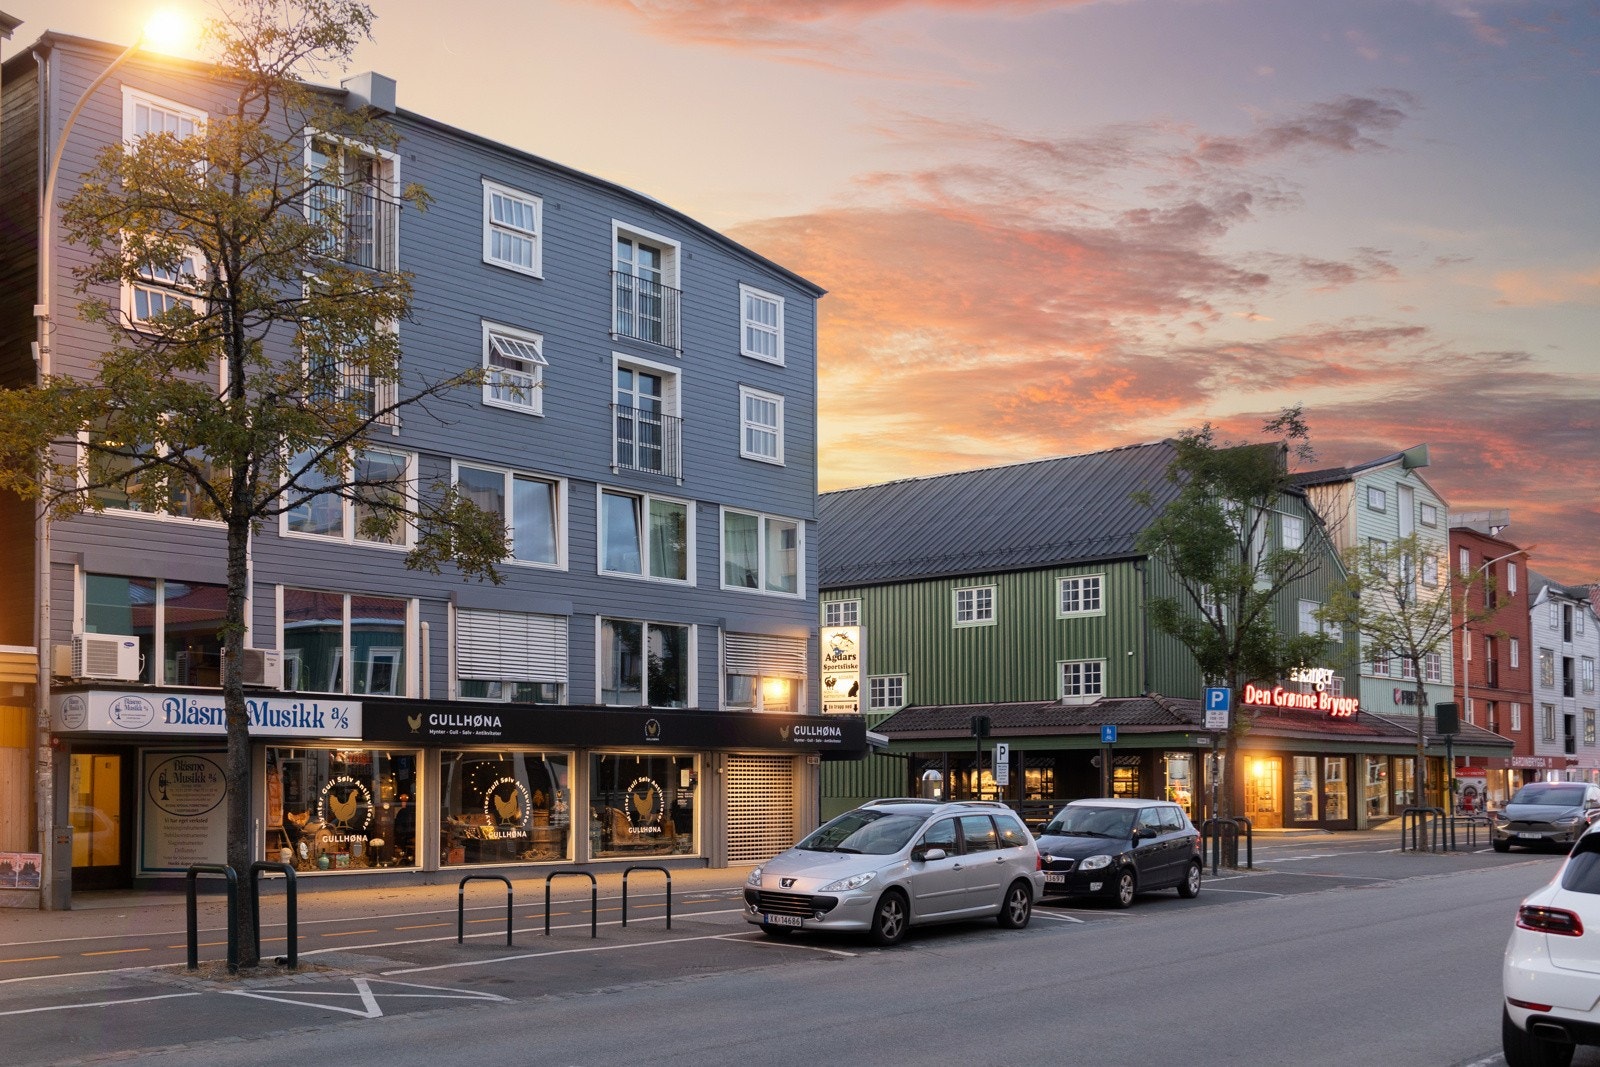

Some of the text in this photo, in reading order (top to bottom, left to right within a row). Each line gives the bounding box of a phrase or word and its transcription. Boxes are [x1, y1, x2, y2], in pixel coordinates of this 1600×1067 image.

[825, 654, 856, 663] Agdars
[1212, 692, 1224, 707] P
[1245, 684, 1358, 716] Den Grønne Brygge
[162, 697, 349, 731] Blåsm Musikk a/s
[429, 714, 502, 727] GULLHØNA
[794, 726, 841, 736] GULLHØNA
[1000, 746, 1005, 760] P
[174, 760, 204, 771] Blåsmo
[173, 772, 206, 783] Musikk
[488, 780, 499, 794] Gull
[628, 780, 638, 792] Gull
[317, 797, 326, 829] Mynter
[322, 780, 335, 794] Gull
[355, 780, 373, 830] Antikviteter
[781, 916, 800, 925] 14686
